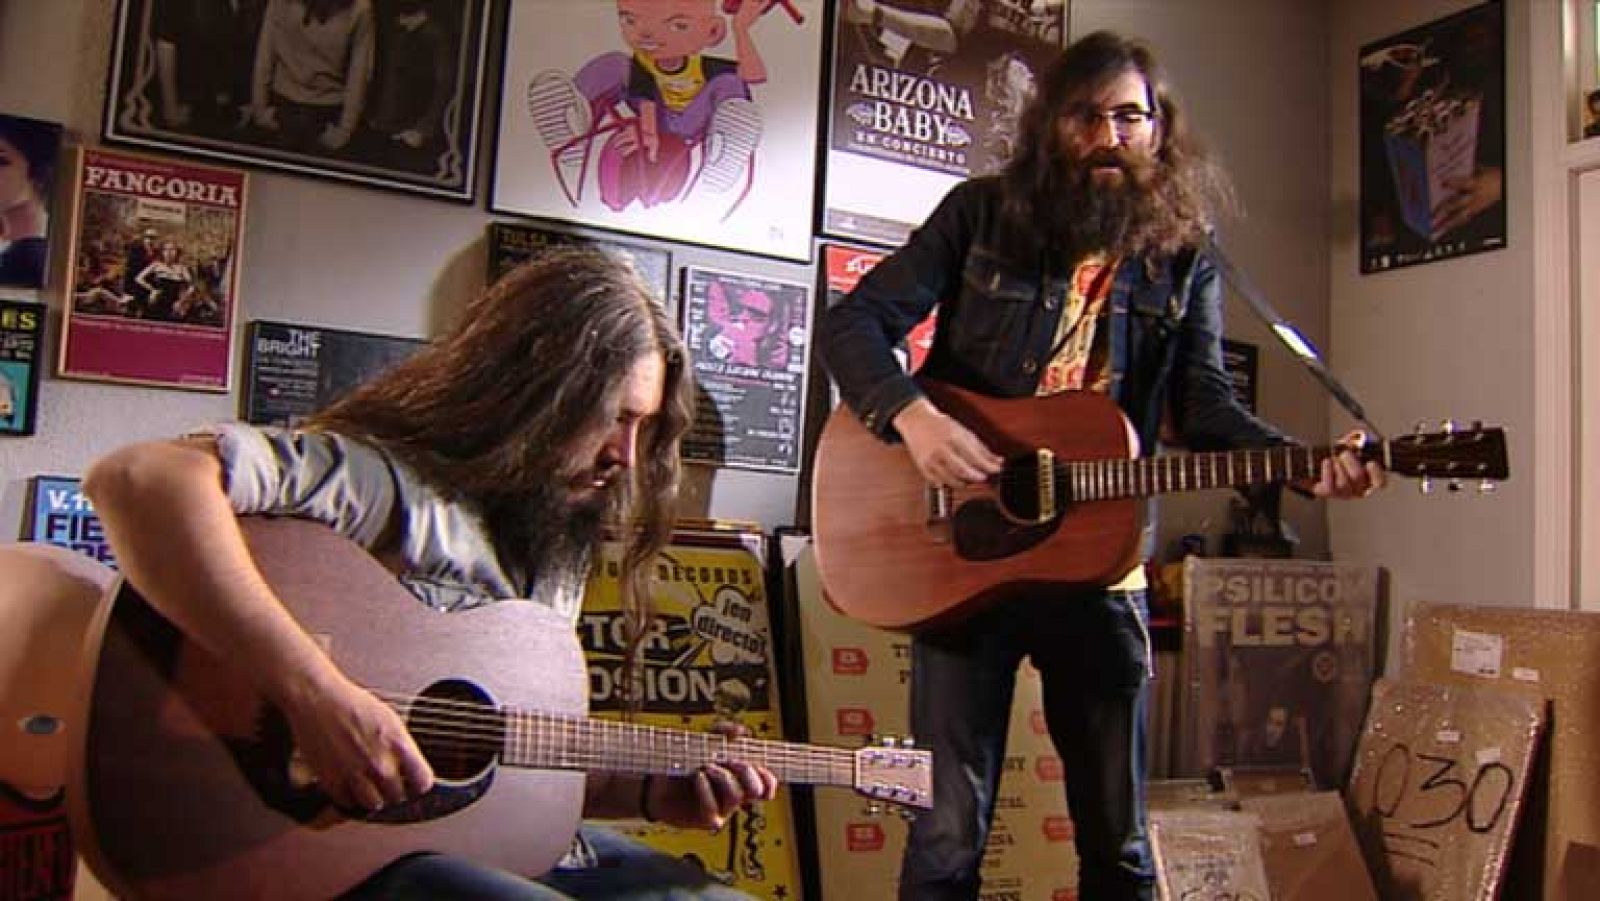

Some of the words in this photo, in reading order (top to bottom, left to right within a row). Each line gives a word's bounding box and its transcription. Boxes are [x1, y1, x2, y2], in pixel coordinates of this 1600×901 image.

[850, 64, 975, 120] ARIZONA
[873, 101, 956, 146] BABY
[84, 166, 238, 206] FANGORIA
[257, 337, 321, 358] BRIGHT
[288, 328, 321, 347] THE
[658, 564, 752, 584] RECORDS
[1198, 607, 1368, 648] FLESH
[1373, 743, 1514, 833] 030
